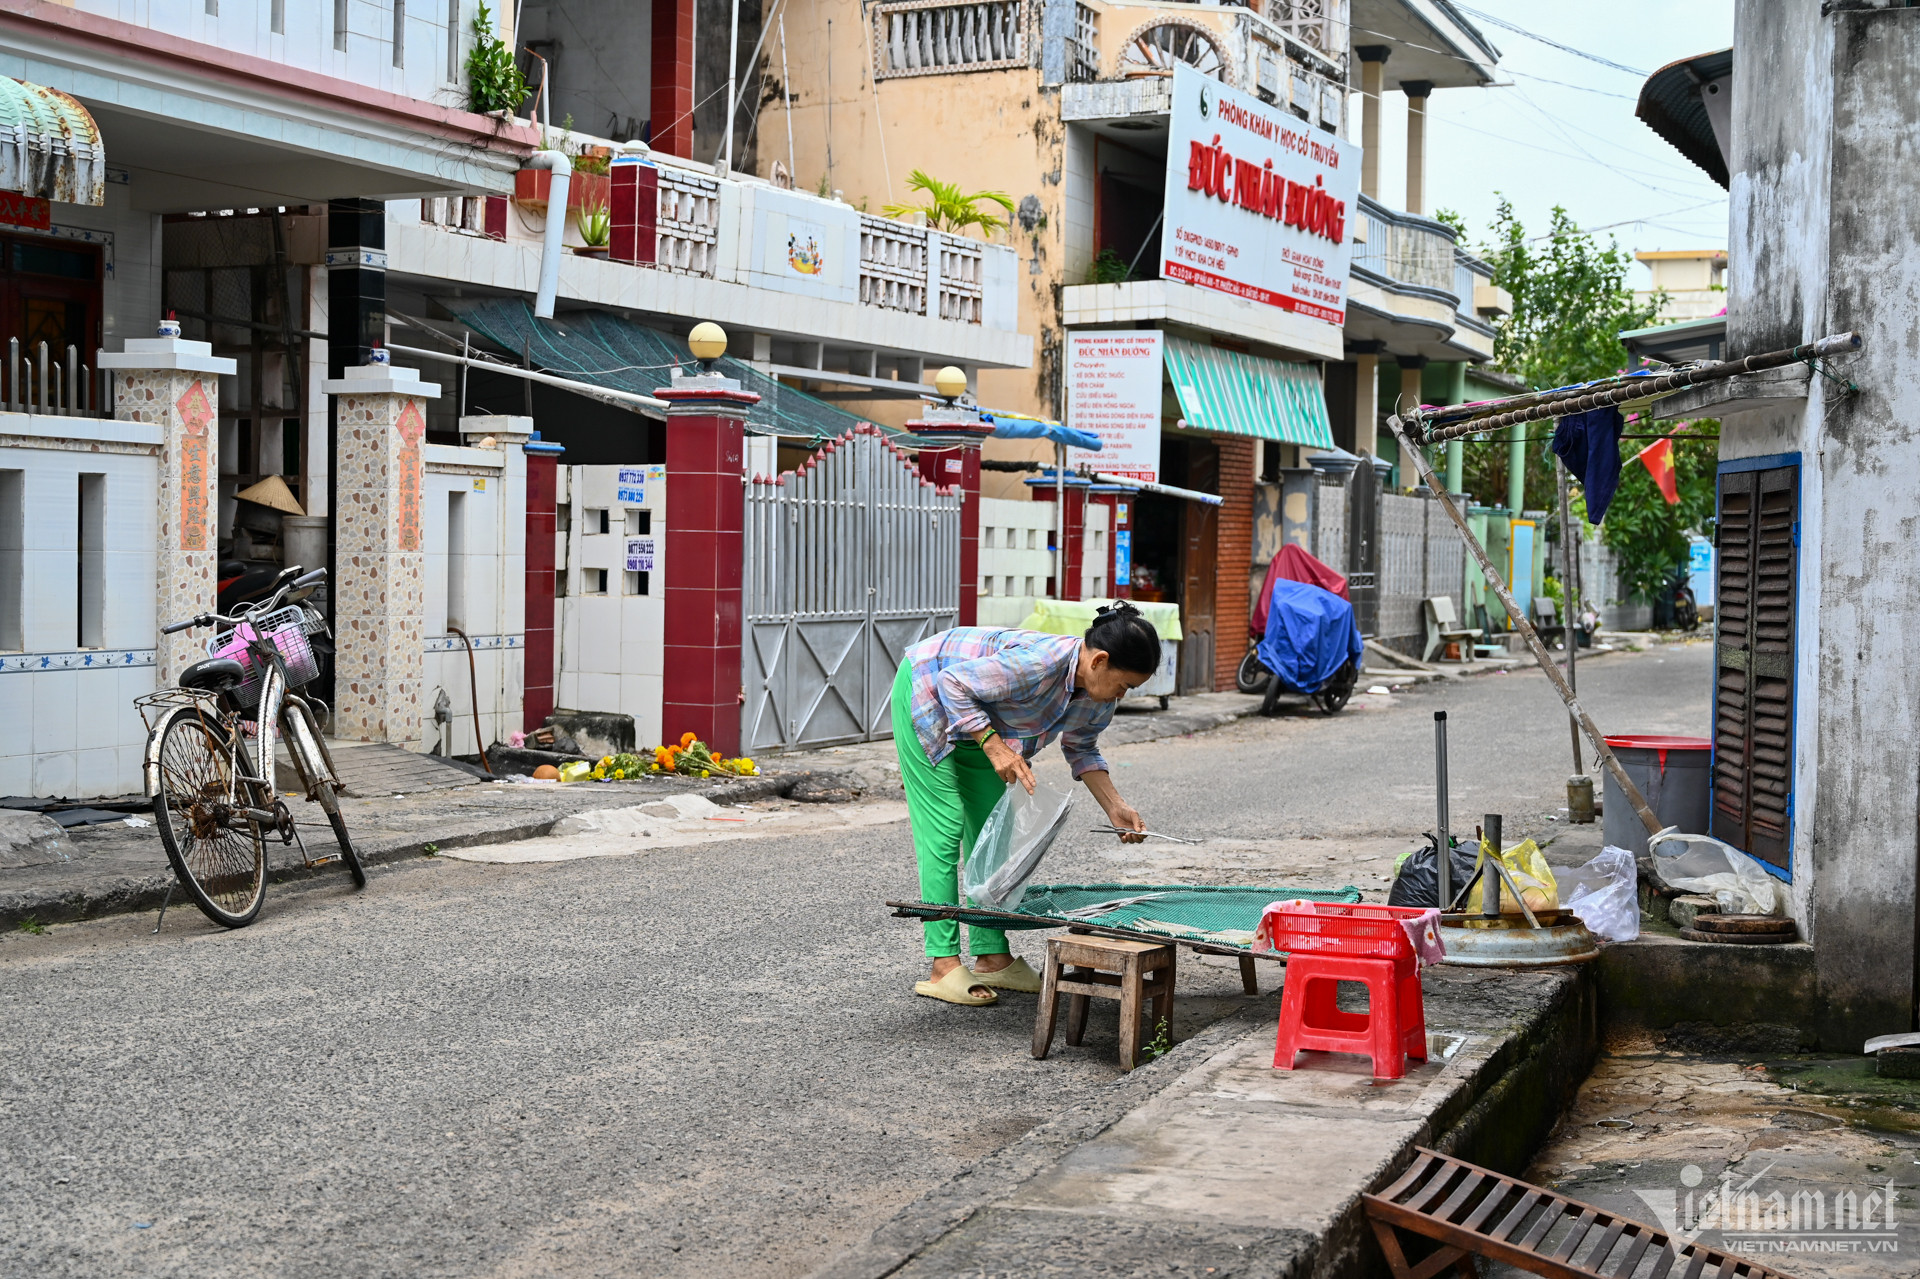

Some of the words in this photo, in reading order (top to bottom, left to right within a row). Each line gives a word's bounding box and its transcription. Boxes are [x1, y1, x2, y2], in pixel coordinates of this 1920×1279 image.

[1218, 99, 1248, 129] PHÒNG
[1250, 112, 1272, 140] KHÁM
[1274, 125, 1280, 142] Y
[1281, 130, 1296, 154] HỌC
[1298, 130, 1309, 156] CỔ
[1188, 134, 1233, 202] ĐỨC
[1232, 158, 1287, 222] NHÂN
[1284, 174, 1346, 244] ĐƯỜNG
[1079, 346, 1095, 356] ĐỨC
[1098, 347, 1119, 356] NHÂN
[1122, 346, 1150, 356] ĐƯỜNG
